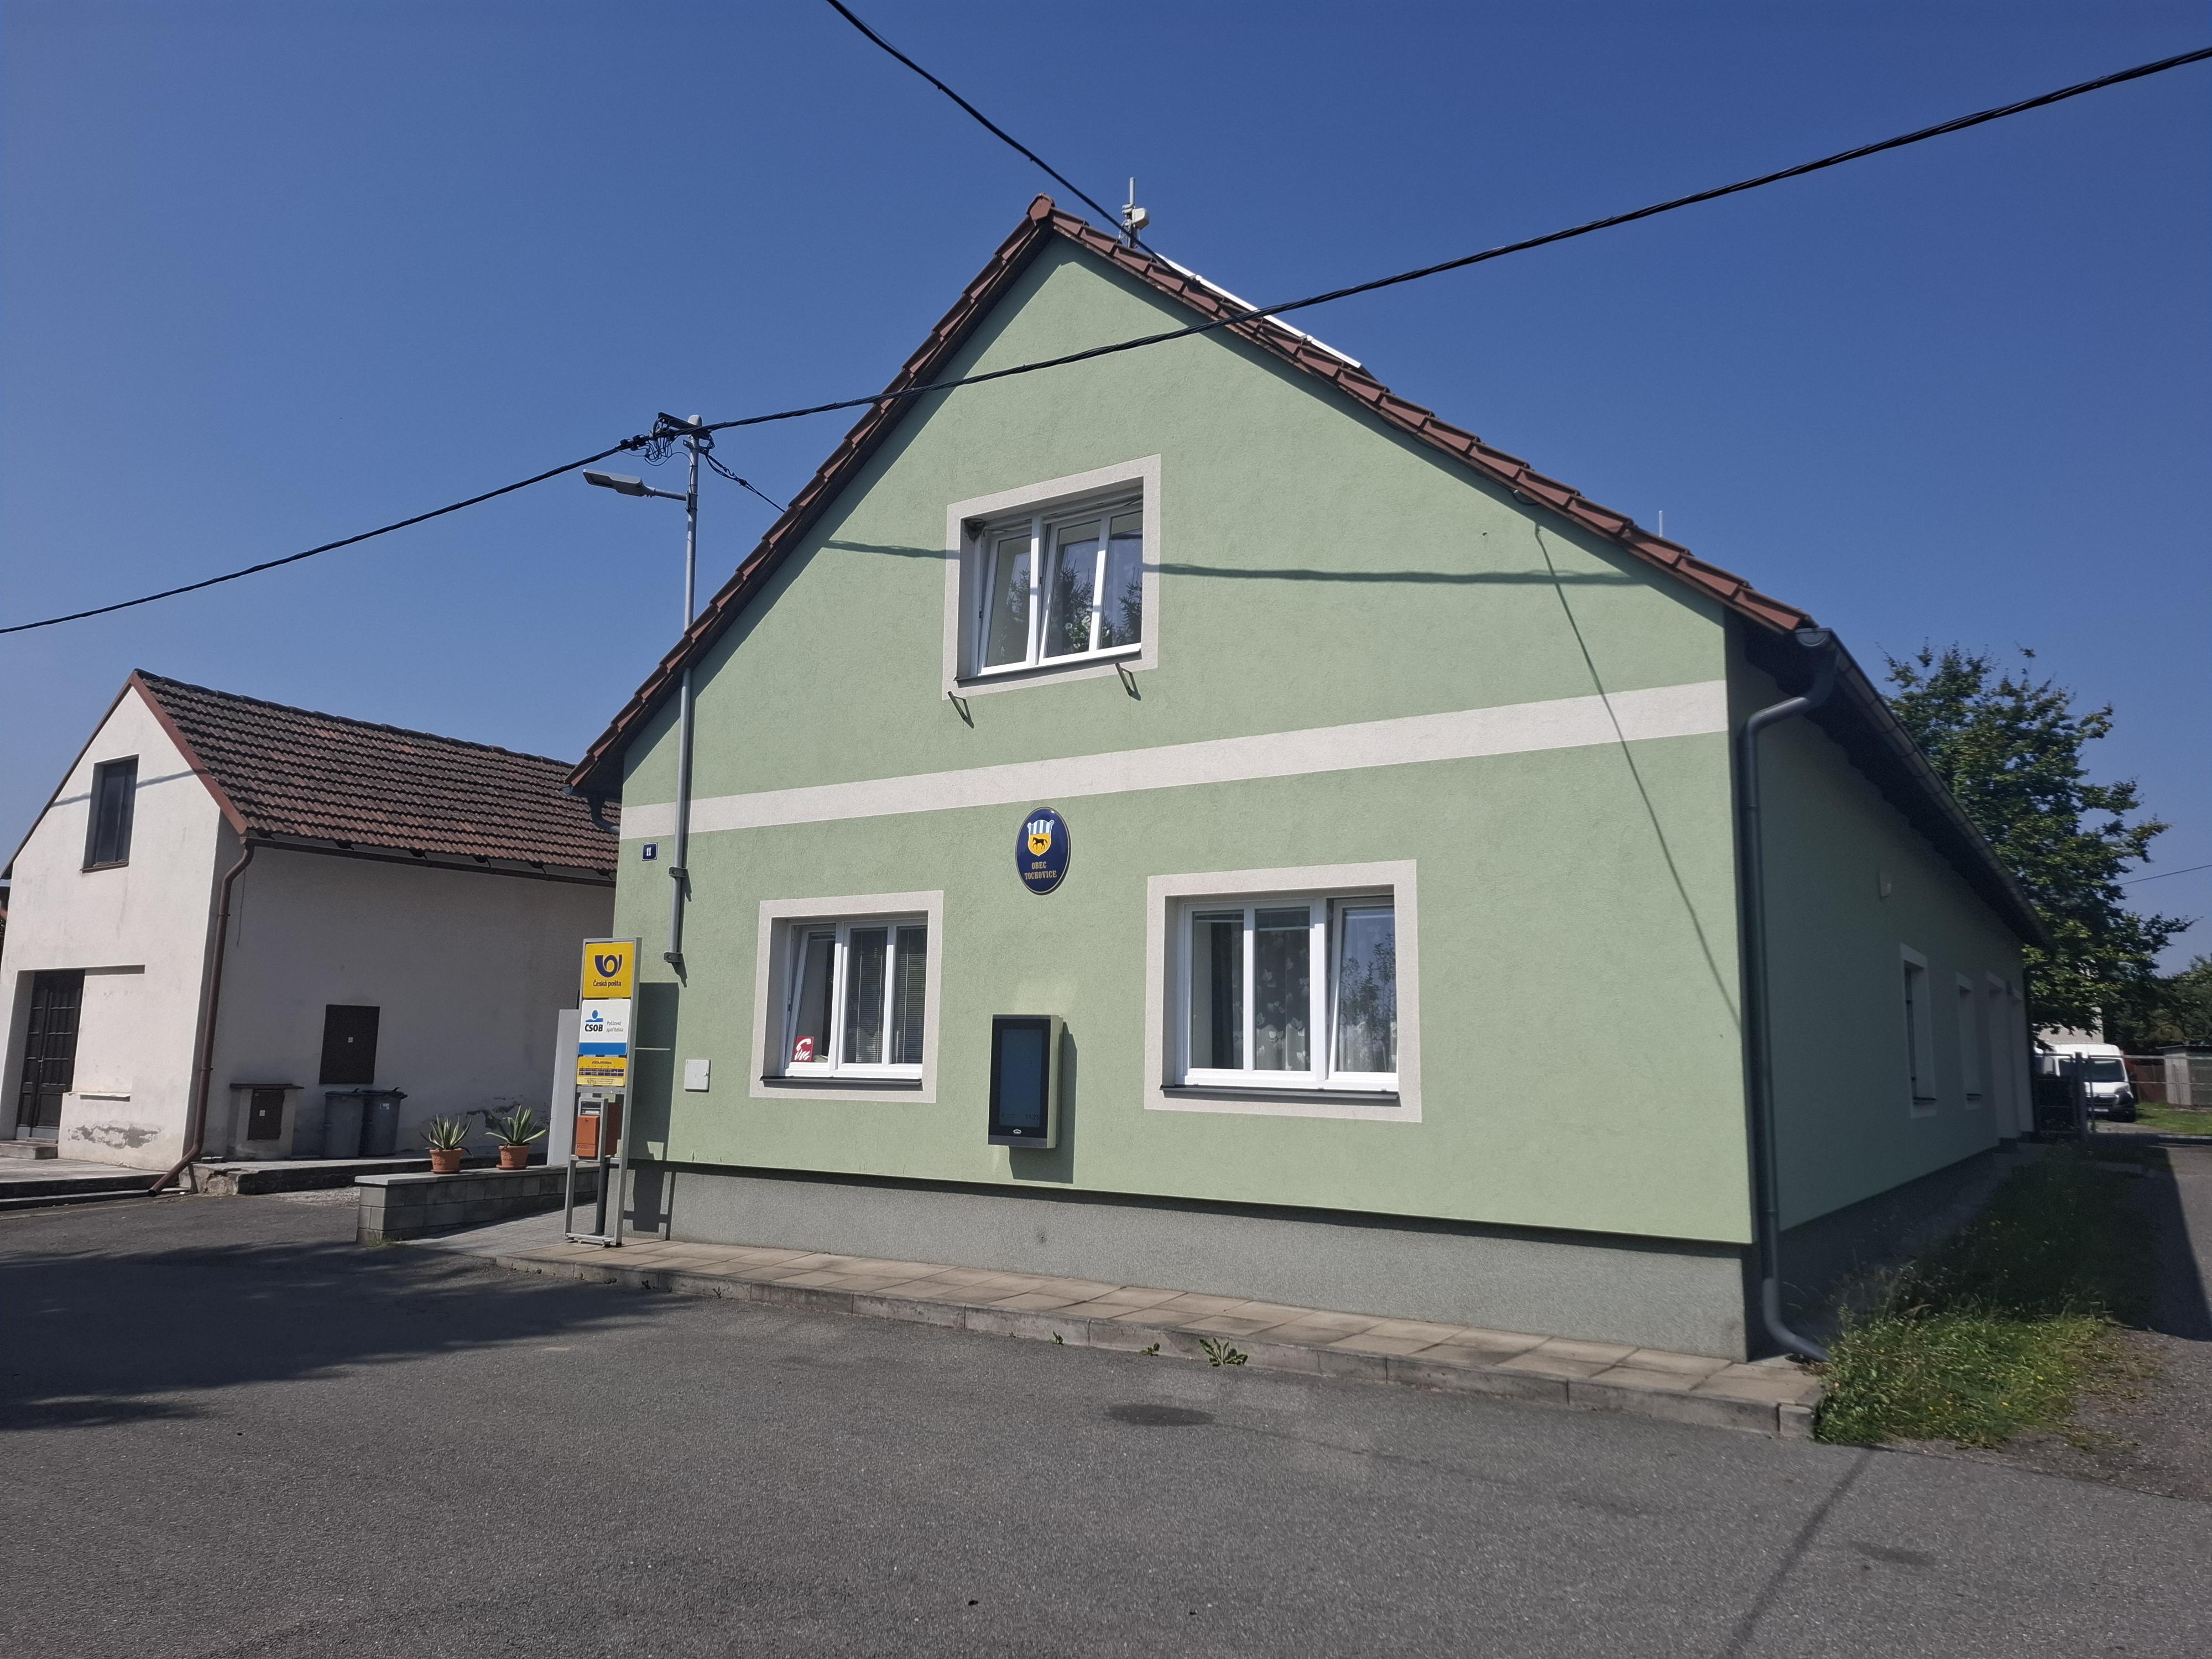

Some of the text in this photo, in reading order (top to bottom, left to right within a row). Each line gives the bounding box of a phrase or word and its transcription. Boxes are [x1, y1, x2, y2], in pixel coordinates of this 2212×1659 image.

[646, 847, 651, 857] 11
[1031, 861, 1047, 869] OBEC
[1024, 870, 1057, 880] TOCHOVICE
[585, 1023, 603, 1032] ČSOB
